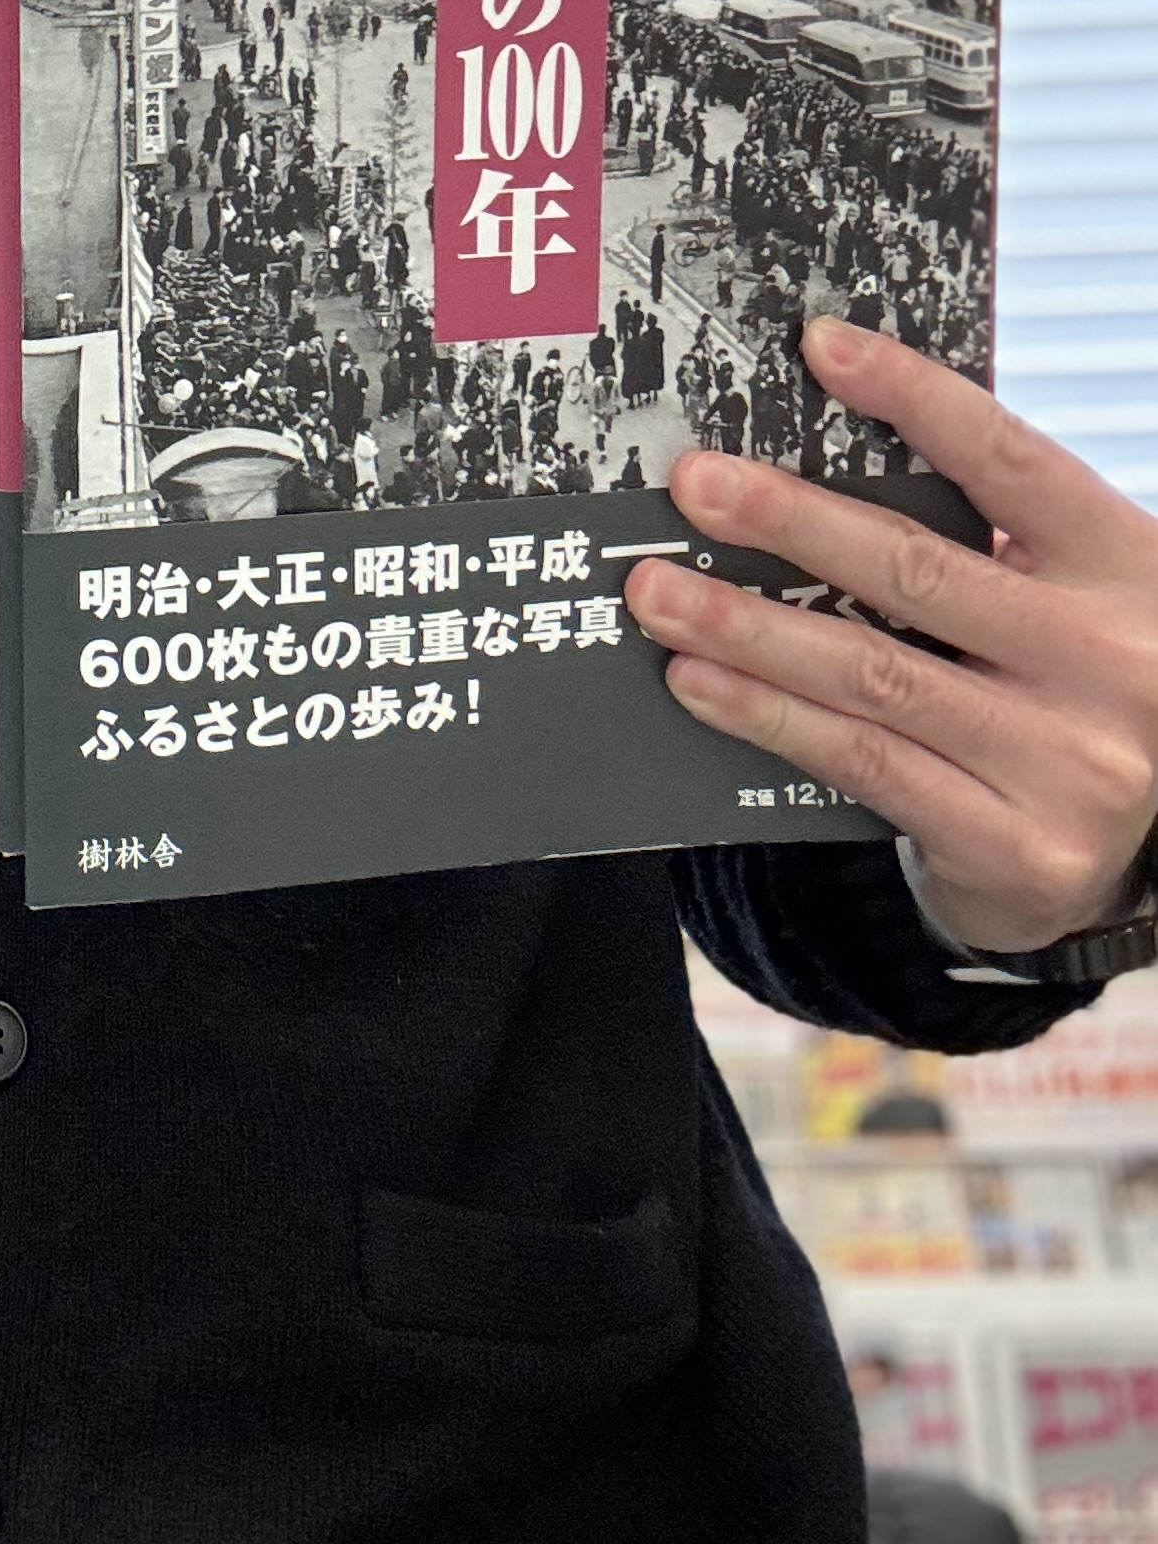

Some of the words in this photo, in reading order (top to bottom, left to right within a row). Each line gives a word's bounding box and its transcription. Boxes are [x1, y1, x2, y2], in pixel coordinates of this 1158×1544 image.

[737, 788, 775, 807] 定価
[77, 832, 183, 874] 樹林舎
